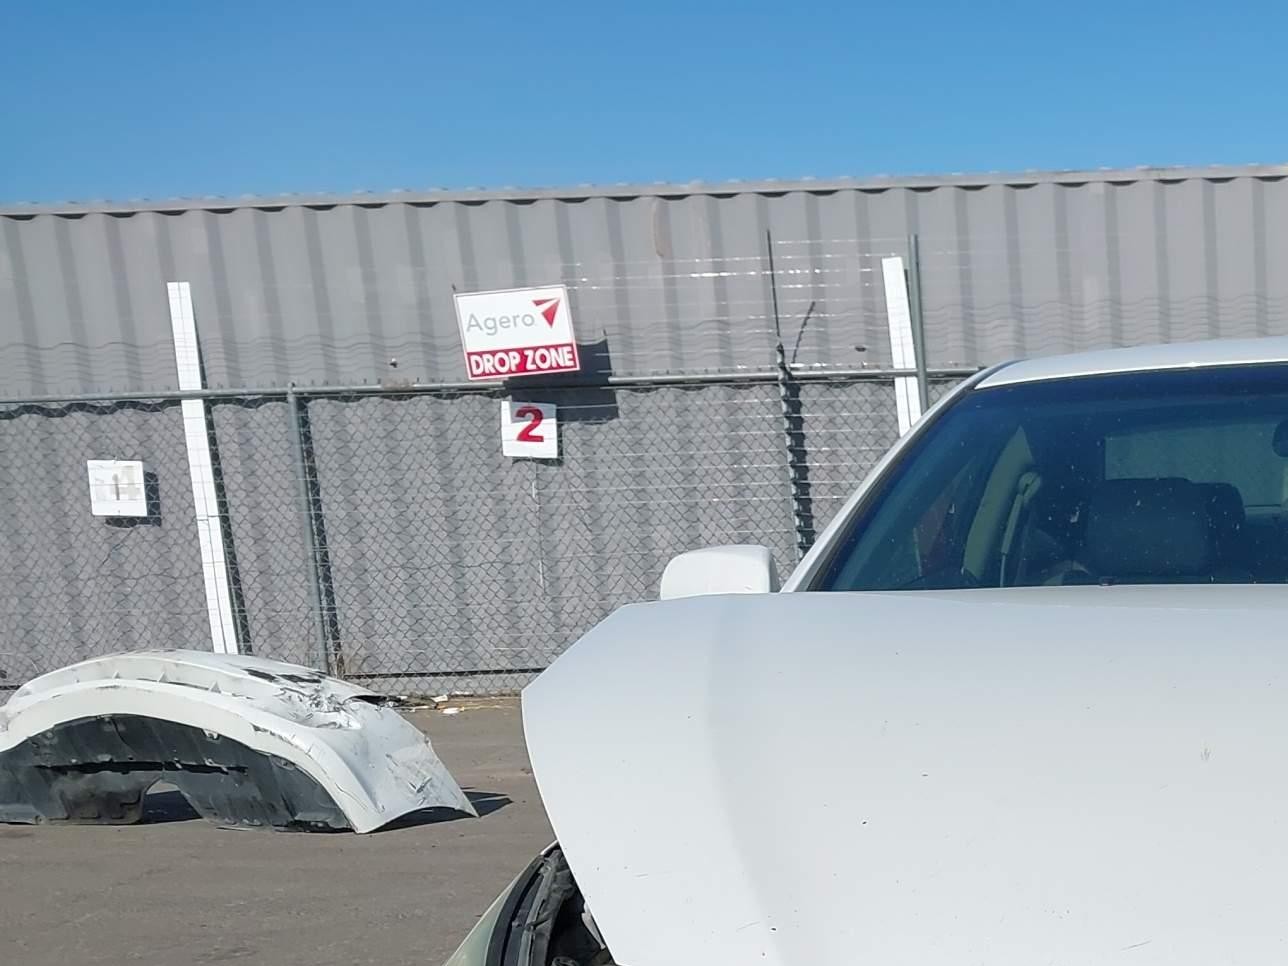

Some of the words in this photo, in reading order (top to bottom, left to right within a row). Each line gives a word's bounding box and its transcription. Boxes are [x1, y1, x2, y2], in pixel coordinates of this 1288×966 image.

[466, 313, 535, 336] Agero
[470, 351, 521, 375] DROP
[523, 346, 575, 370] ZONE
[515, 406, 544, 442] 2
